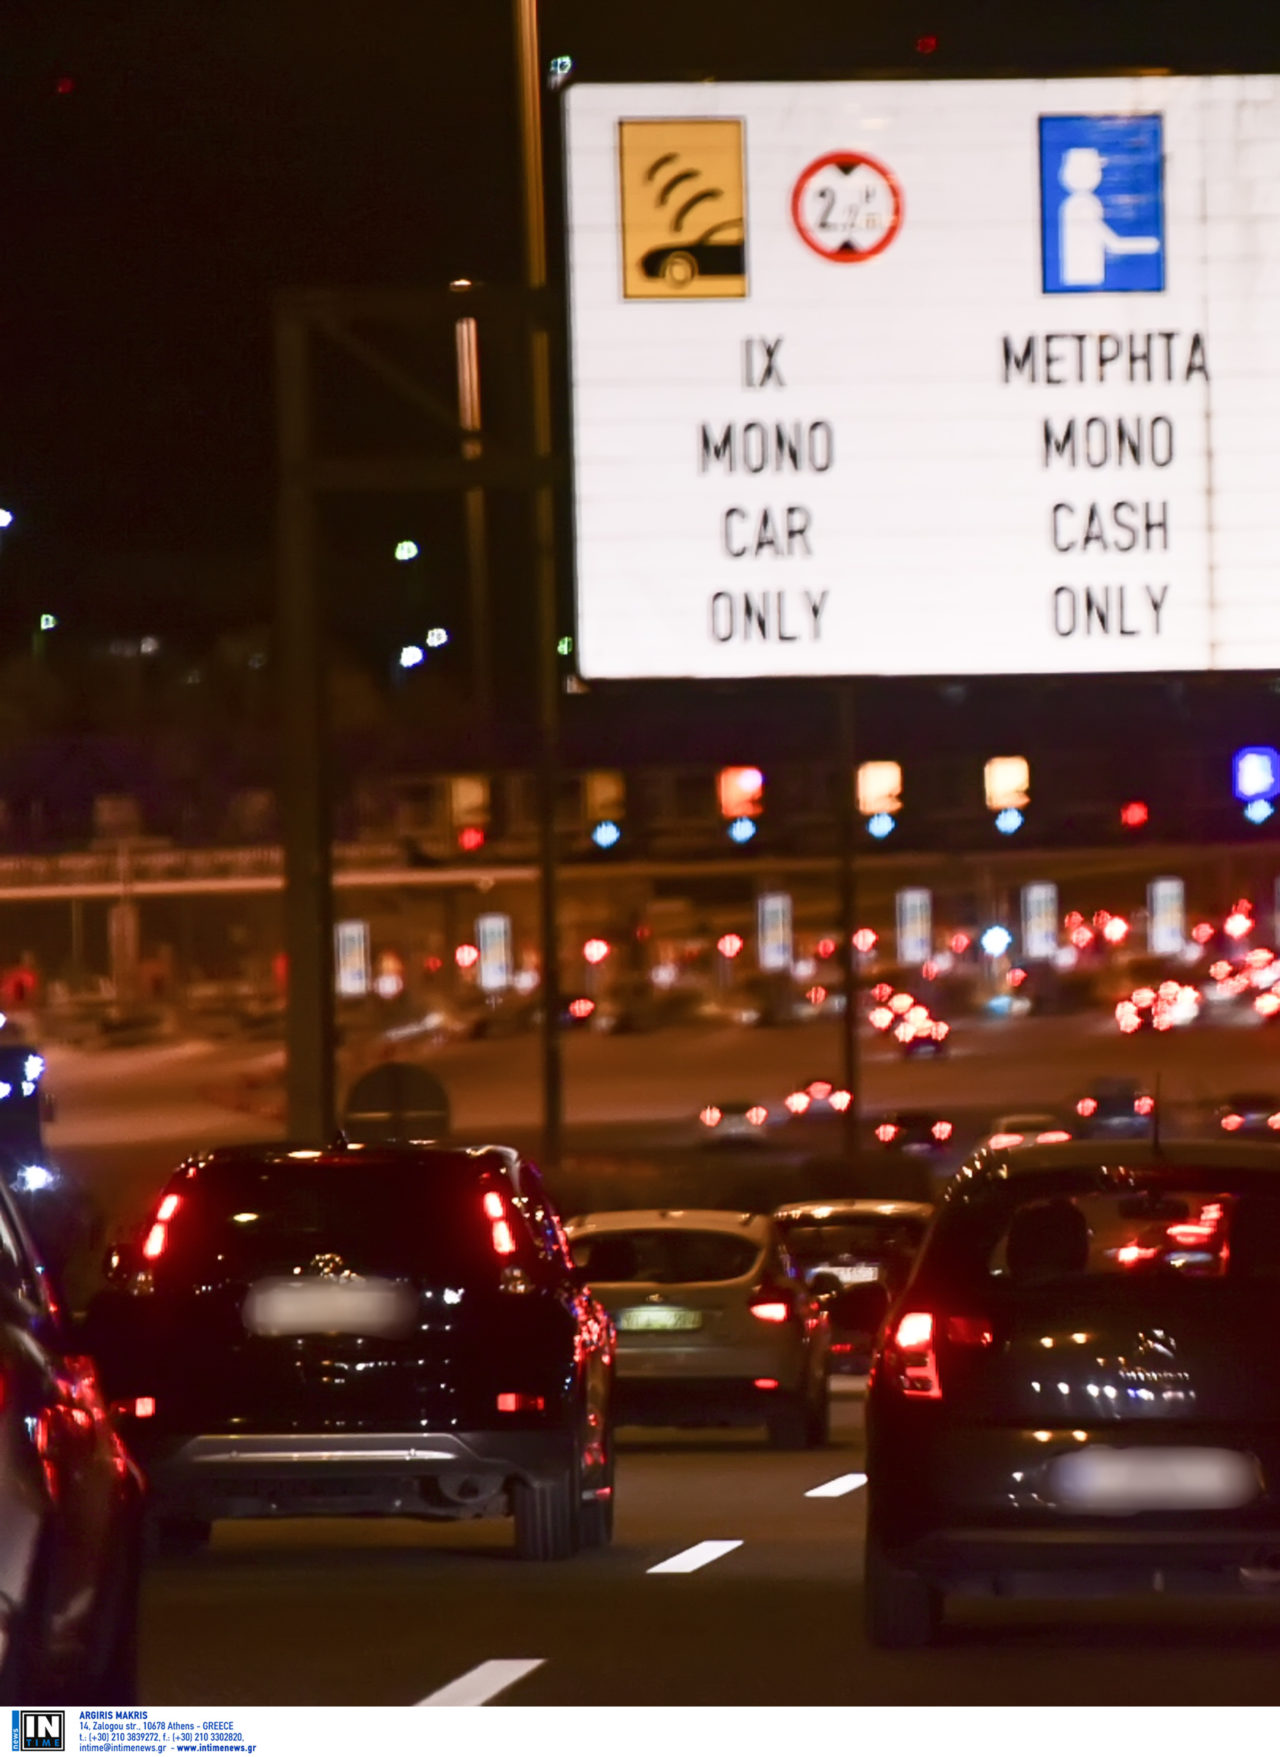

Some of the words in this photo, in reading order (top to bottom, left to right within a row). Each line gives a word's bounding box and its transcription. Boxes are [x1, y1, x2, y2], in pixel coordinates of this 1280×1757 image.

[742, 337, 786, 388] ΙΧ
[1001, 330, 1208, 385] ΜΕΤΡΗΤΑ
[700, 420, 834, 475] ΜΟΝΟ
[1042, 414, 1175, 469] ΜΟΝΟ
[723, 505, 812, 559] CAR
[1051, 500, 1169, 553] CASH
[711, 589, 829, 643] ONLY
[1053, 584, 1168, 638] ONLY
